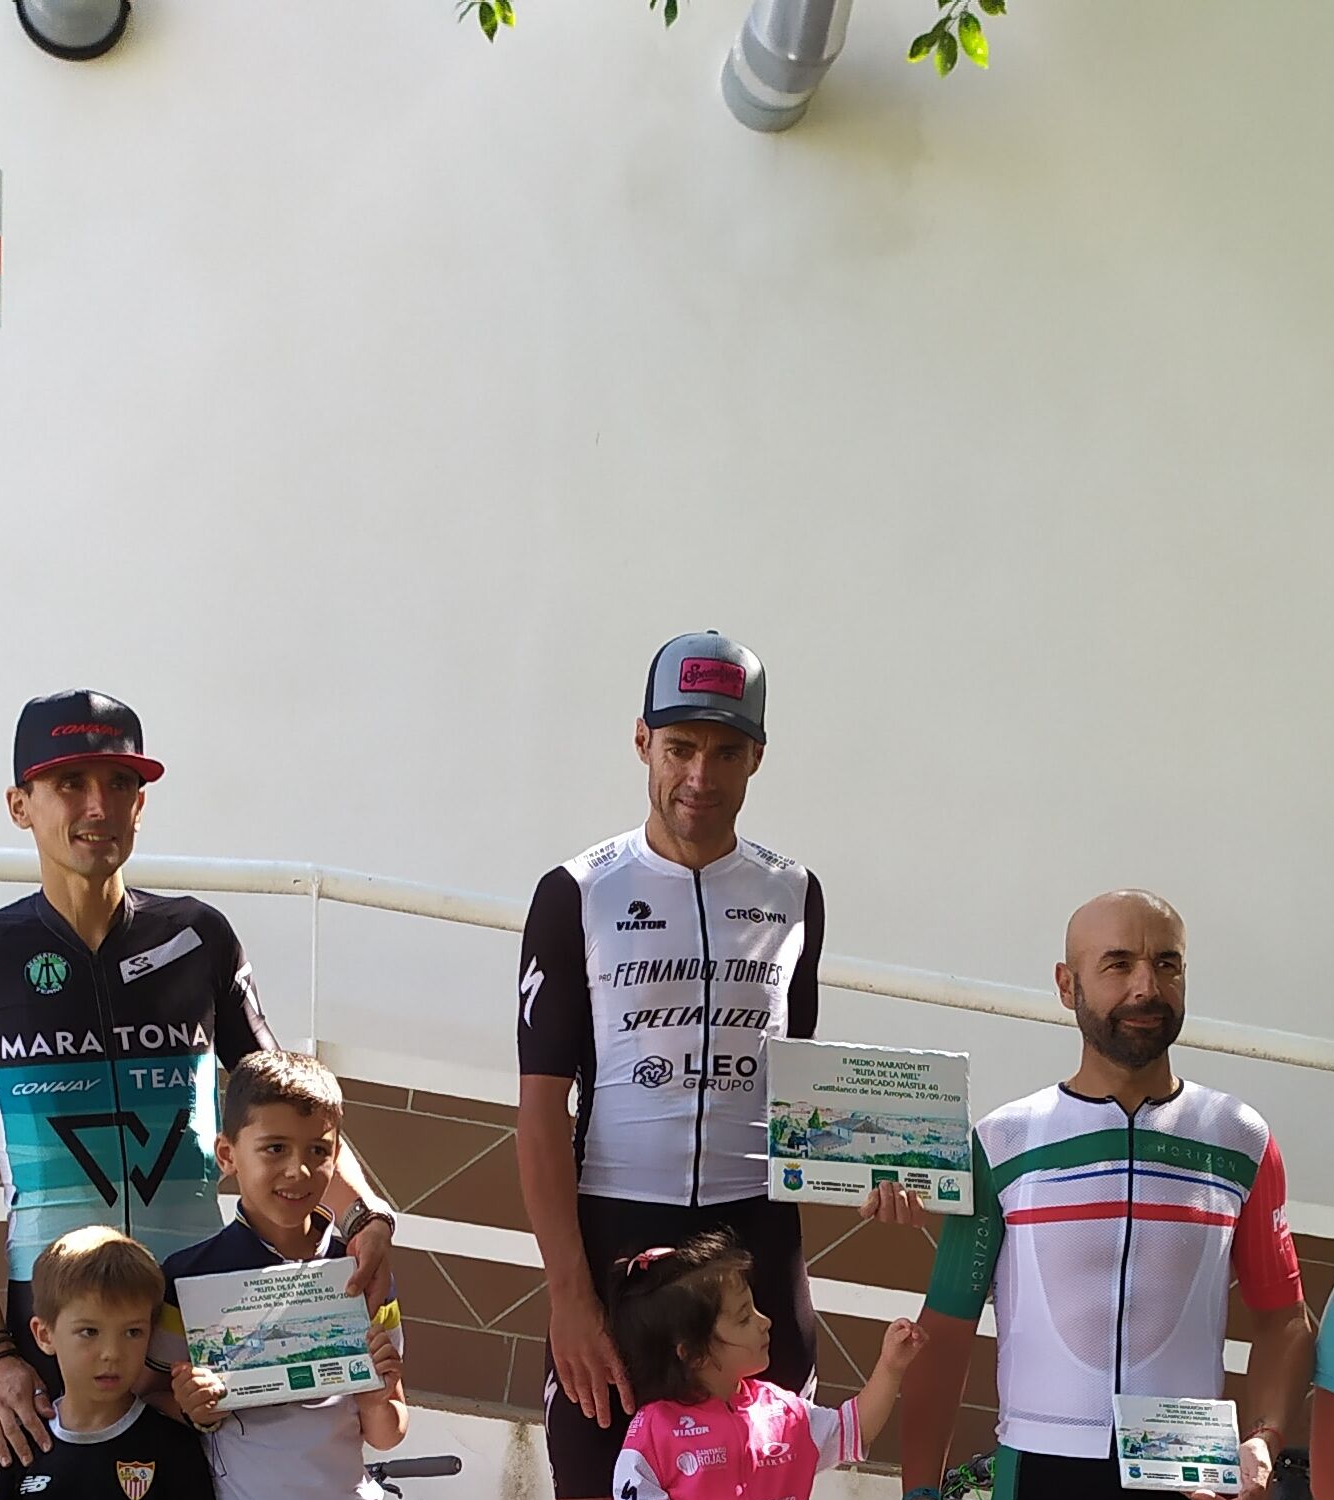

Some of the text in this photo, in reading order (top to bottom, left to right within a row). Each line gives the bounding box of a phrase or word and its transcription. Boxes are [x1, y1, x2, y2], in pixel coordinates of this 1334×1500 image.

[725, 907, 787, 924] CROWN
[616, 920, 667, 931] VIATOR
[618, 1006, 771, 1032] SPECIALIZED
[683, 1053, 758, 1077] LEO
[849, 1058, 875, 1068] MEDIO
[917, 1064, 930, 1073] BTT
[877, 1070, 890, 1078] DE
[891, 1071, 900, 1079] LA
[11, 1078, 101, 1096] CONWAY
[683, 1078, 755, 1092] GRUPO
[928, 1083, 939, 1091] 40
[859, 1087, 869, 1095] de
[870, 1088, 882, 1096] los
[915, 1091, 961, 1103] 29/09/2019
[1157, 1144, 1236, 1172] HORIZON
[971, 1214, 989, 1291] HORIZON
[672, 1426, 709, 1437] VIATOR
[698, 1454, 727, 1466] ROJAS
